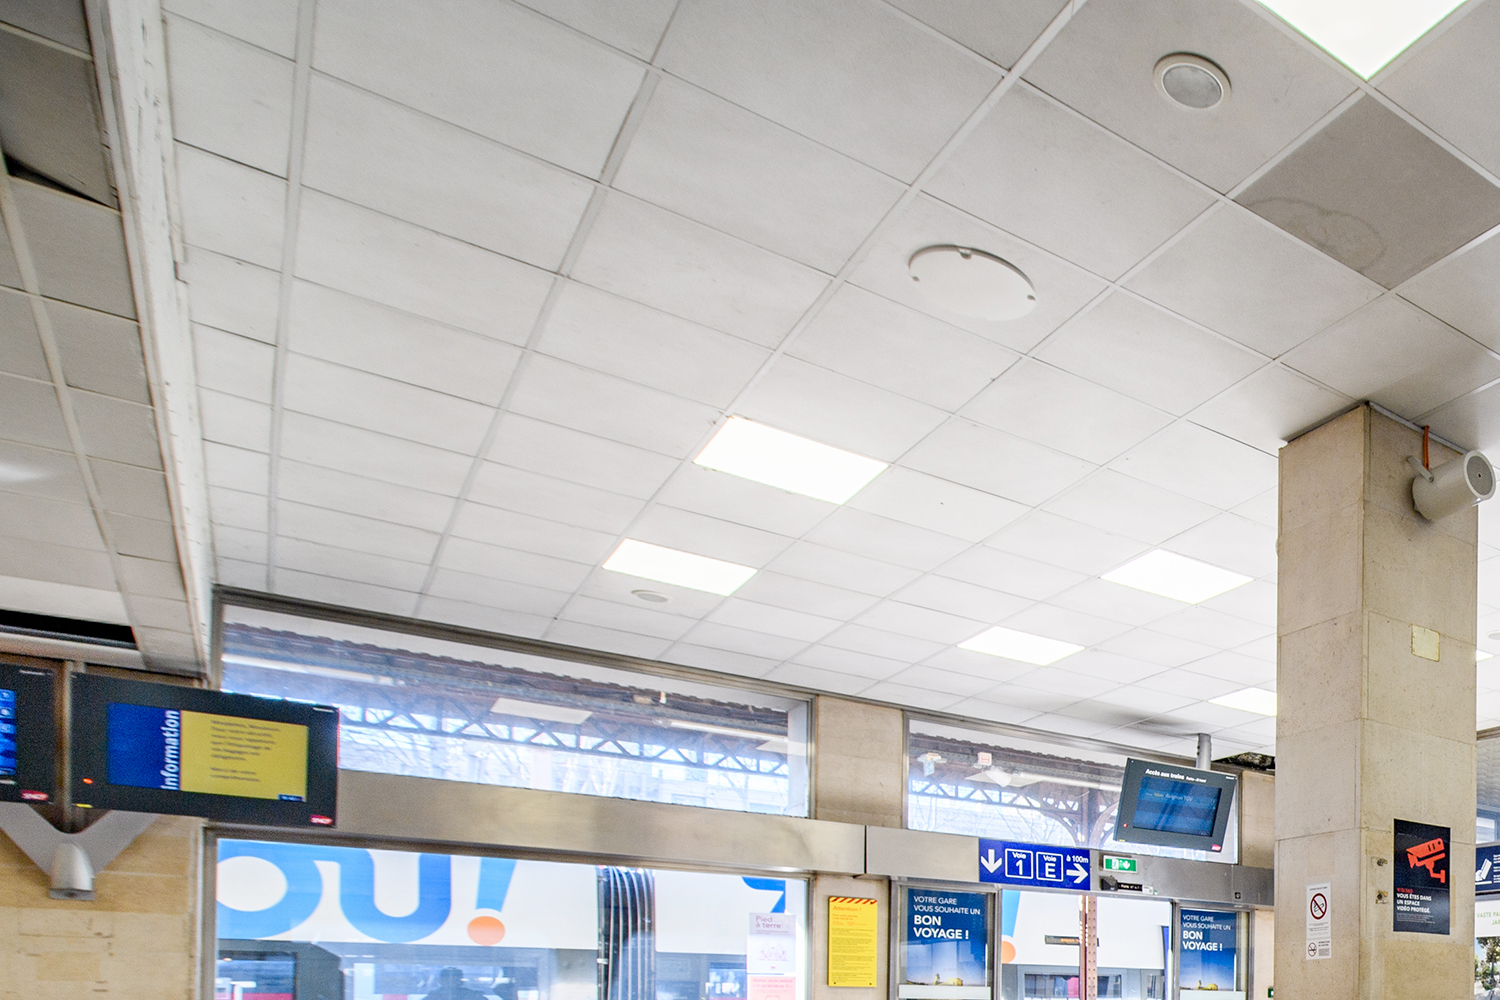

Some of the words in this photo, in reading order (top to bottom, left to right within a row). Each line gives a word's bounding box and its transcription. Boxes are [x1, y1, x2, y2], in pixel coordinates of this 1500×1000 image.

[160, 709, 180, 790] Information
[1012, 851, 1027, 860] Voie
[1043, 854, 1057, 863] Voie
[1072, 855, 1089, 864] 100m
[1016, 859, 1024, 876] 1
[1045, 862, 1056, 879] E
[913, 896, 937, 904] VOTRE
[938, 897, 958, 906] GARE
[913, 904, 934, 912] VOUS
[934, 905, 970, 914] SOUHAITE
[755, 915, 773, 924] Pied
[914, 914, 942, 926] BON
[1183, 914, 1200, 922] VOTRE
[762, 921, 782, 930] terre
[1198, 922, 1222, 931] SOUHAITE
[913, 927, 963, 939] VOYAGE
[965, 930, 970, 940] !
[1182, 930, 1203, 940] BON
[1182, 941, 1218, 952] VOYAGE
